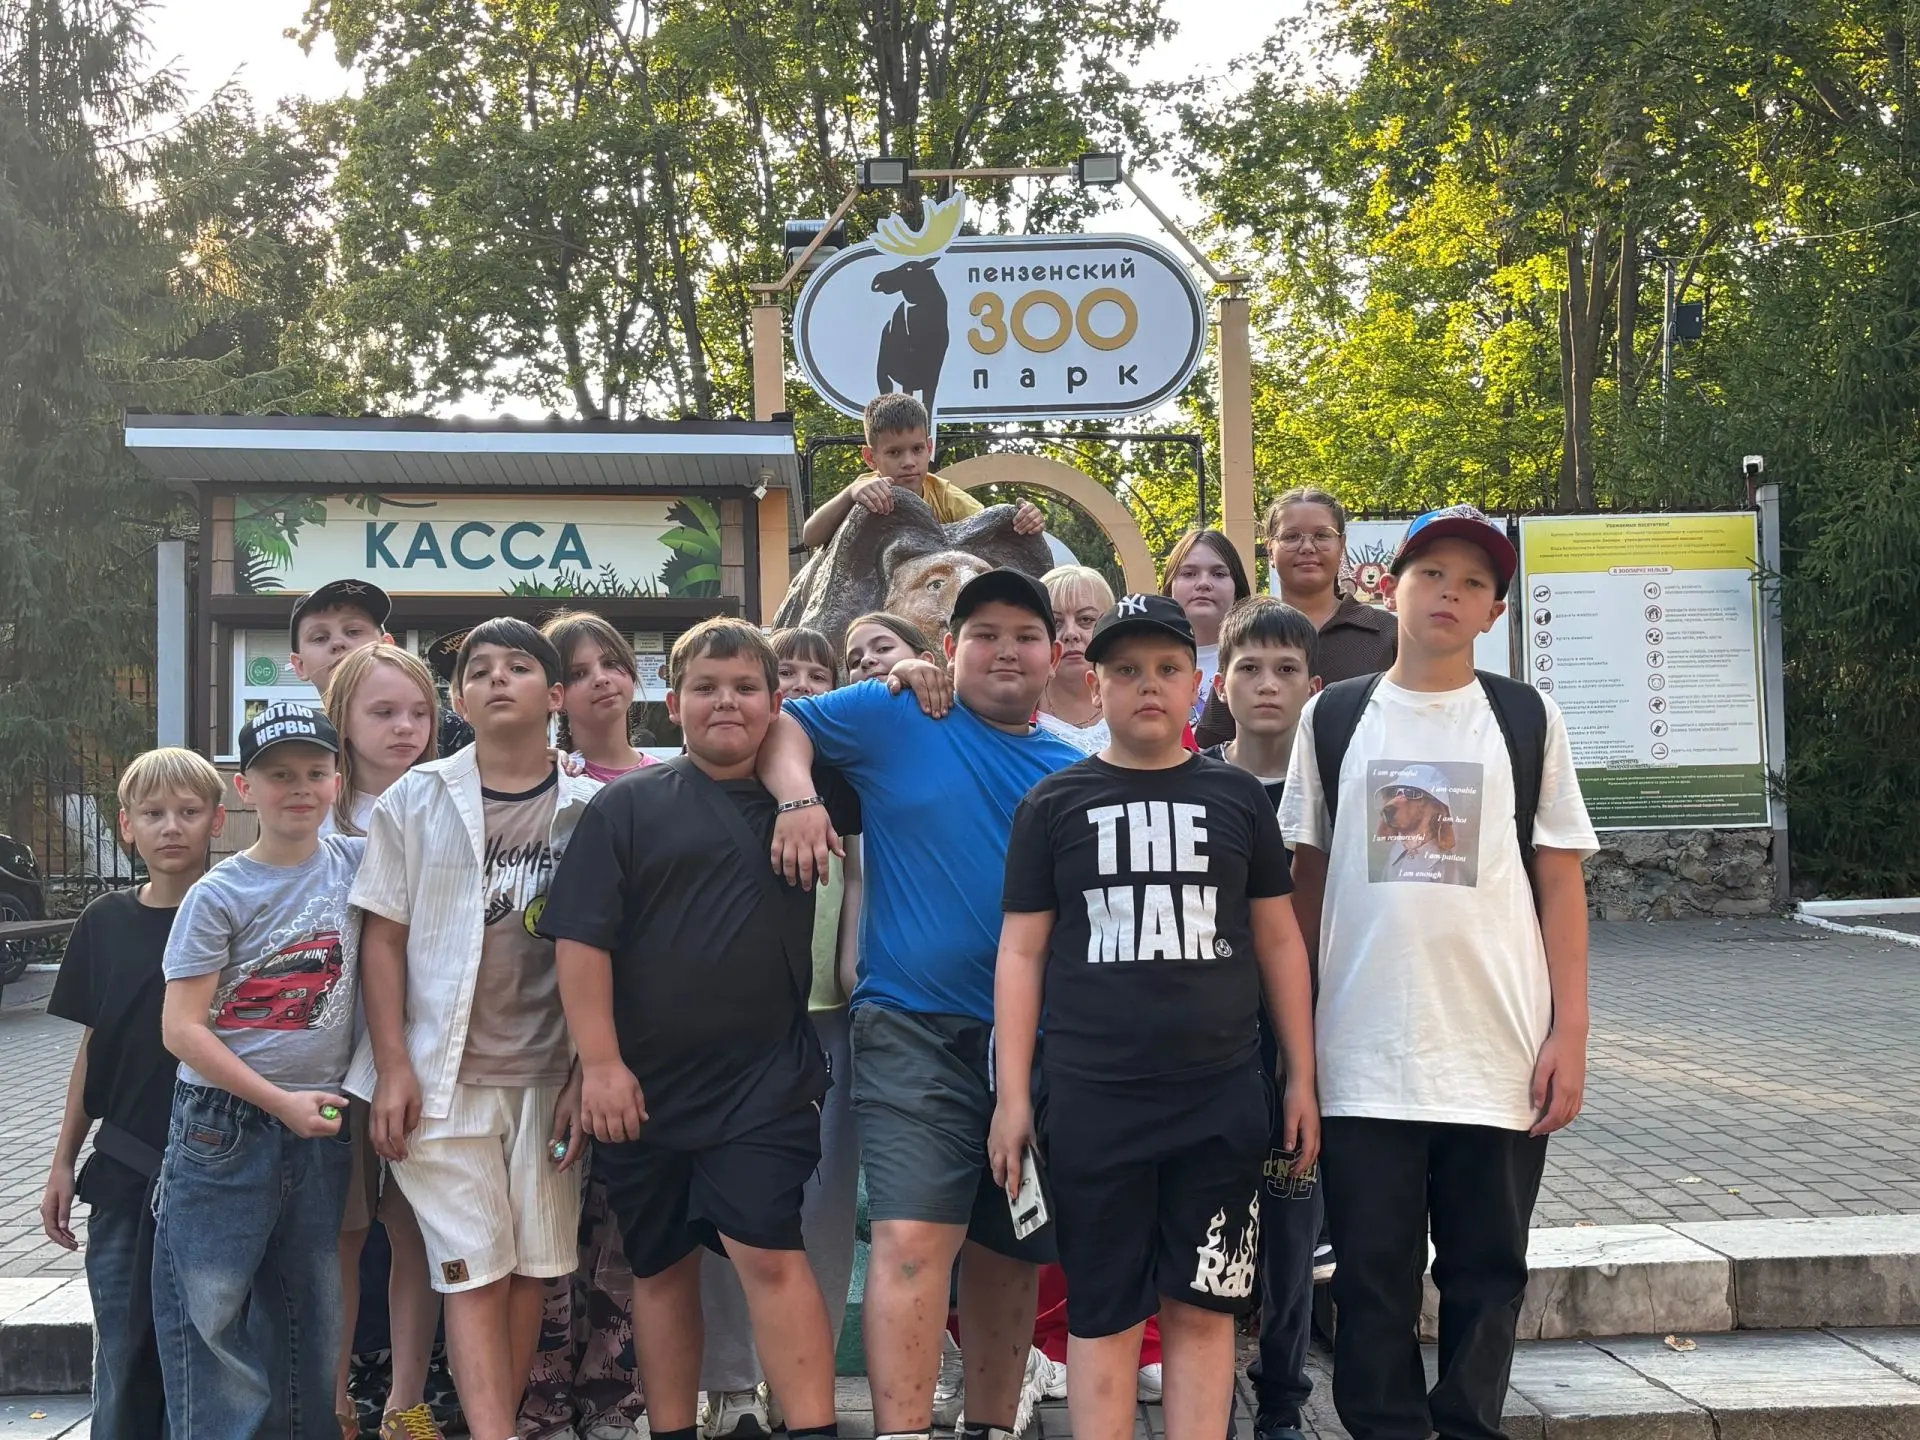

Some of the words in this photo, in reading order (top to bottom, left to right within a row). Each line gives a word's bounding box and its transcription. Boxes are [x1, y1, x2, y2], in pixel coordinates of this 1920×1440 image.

[968, 257, 1135, 284] пензенский
[967, 287, 1139, 355] ЗОО
[973, 363, 1139, 393] парк
[366, 521, 592, 570] КАССА
[1117, 593, 1148, 619] NY
[252, 703, 314, 729] МОТАЮ
[255, 720, 317, 747] НЕРВЫ
[1086, 801, 1210, 875] THE
[1082, 884, 1219, 963] MAN
[304, 948, 328, 964] KING
